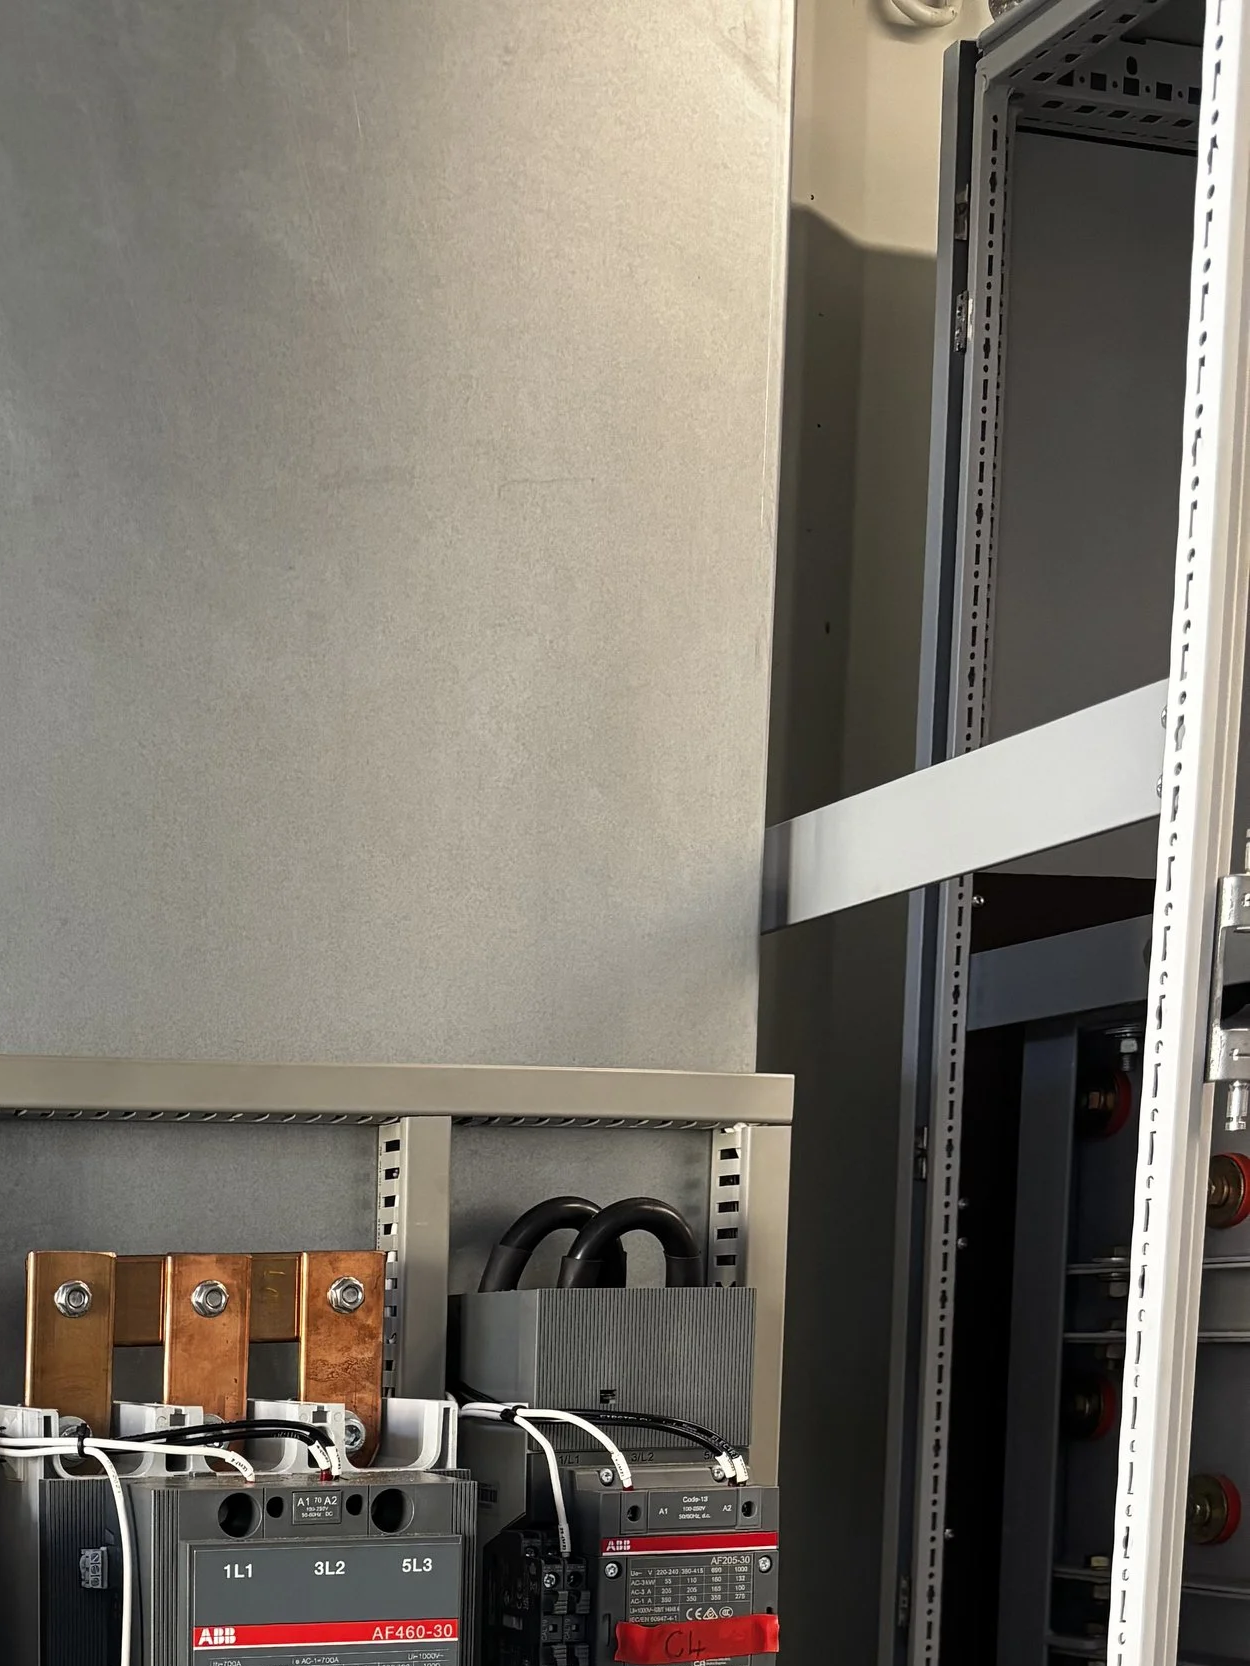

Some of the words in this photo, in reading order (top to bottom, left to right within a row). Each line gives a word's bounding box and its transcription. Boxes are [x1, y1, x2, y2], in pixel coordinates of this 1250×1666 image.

[631, 1453, 654, 1462] 3/L2
[297, 1497, 310, 1506] A1
[324, 1495, 338, 1505] A2
[658, 1507, 668, 1515] A1
[722, 1504, 732, 1512] A2
[606, 1539, 631, 1551] ABB
[710, 1555, 750, 1565] AF205-30
[223, 1563, 253, 1579] 1L1
[313, 1560, 346, 1576] 3L2
[401, 1557, 433, 1573] 5L3
[198, 1627, 237, 1645] ABB
[371, 1624, 453, 1641] AF460-30
[665, 1630, 707, 1658] C4
